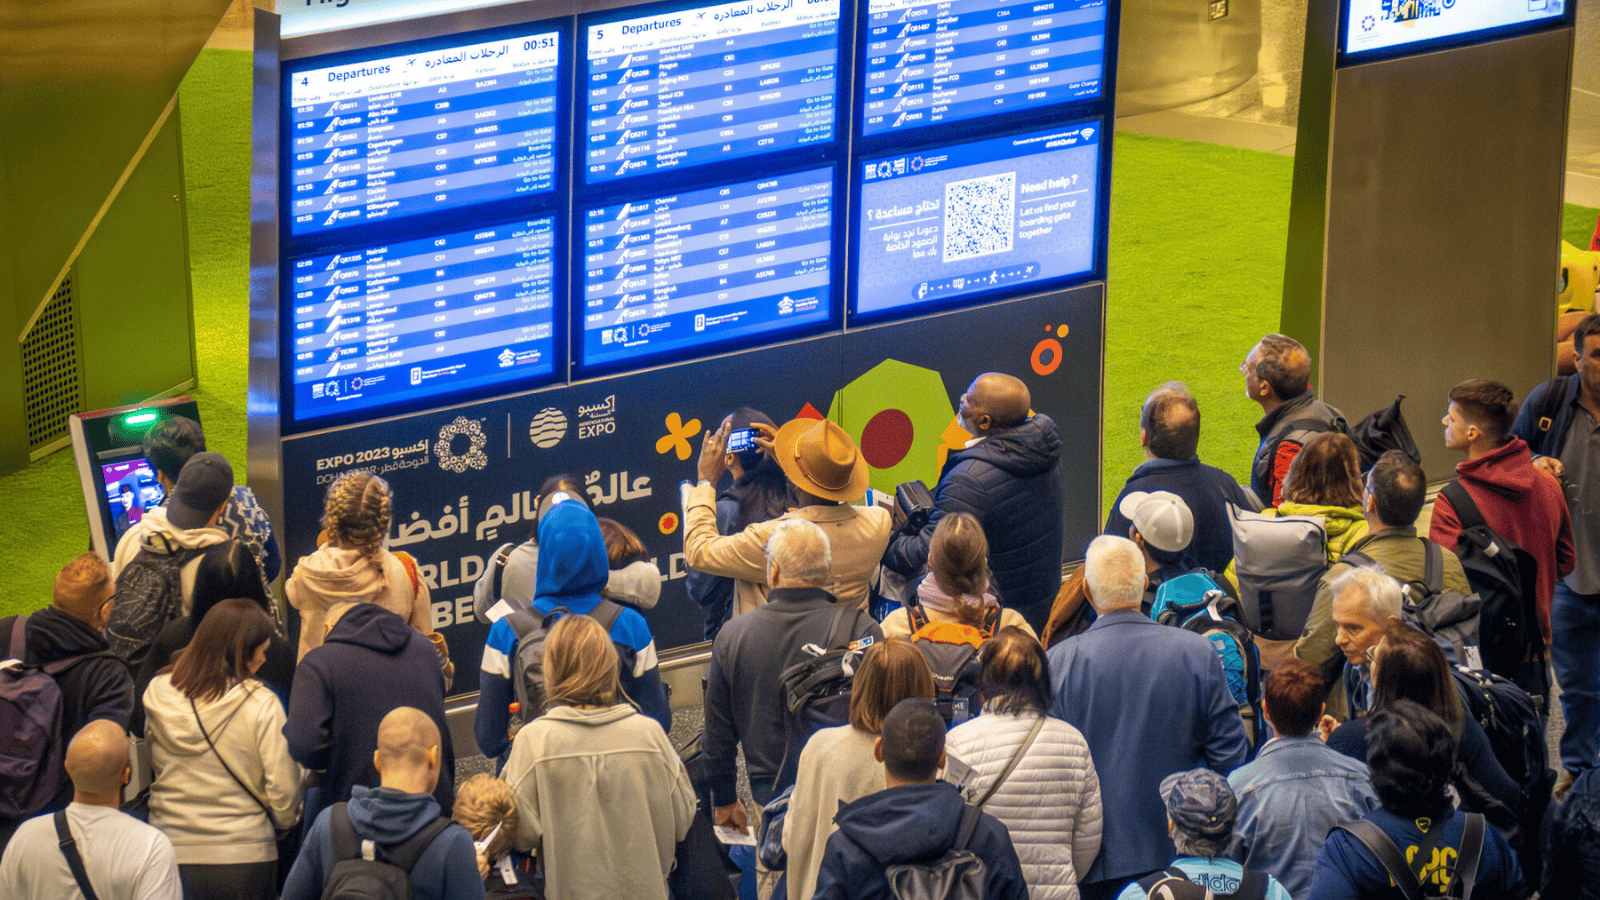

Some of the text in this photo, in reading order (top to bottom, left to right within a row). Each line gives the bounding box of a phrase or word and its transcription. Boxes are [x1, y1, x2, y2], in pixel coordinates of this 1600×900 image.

[597, 18, 682, 40] 5 Departures
[301, 38, 555, 86] 4 Departures 00:51
[380, 107, 398, 116] Dhabi
[657, 122, 676, 130] Athens
[1021, 174, 1078, 194] Need help ?
[1020, 207, 1033, 216] Let
[1044, 202, 1059, 212] find
[1060, 200, 1077, 212] your
[1020, 212, 1071, 228] boarding gate
[1019, 226, 1052, 239] together
[366, 246, 387, 255] Nairobi
[653, 256, 669, 265] Tokyo
[653, 285, 676, 295] Bangkok
[578, 394, 615, 417] إكسبو
[579, 422, 616, 439] EXPO
[392, 439, 429, 459] إكسبو
[316, 446, 390, 471] EXPO 2023
[420, 555, 484, 590] RLD
